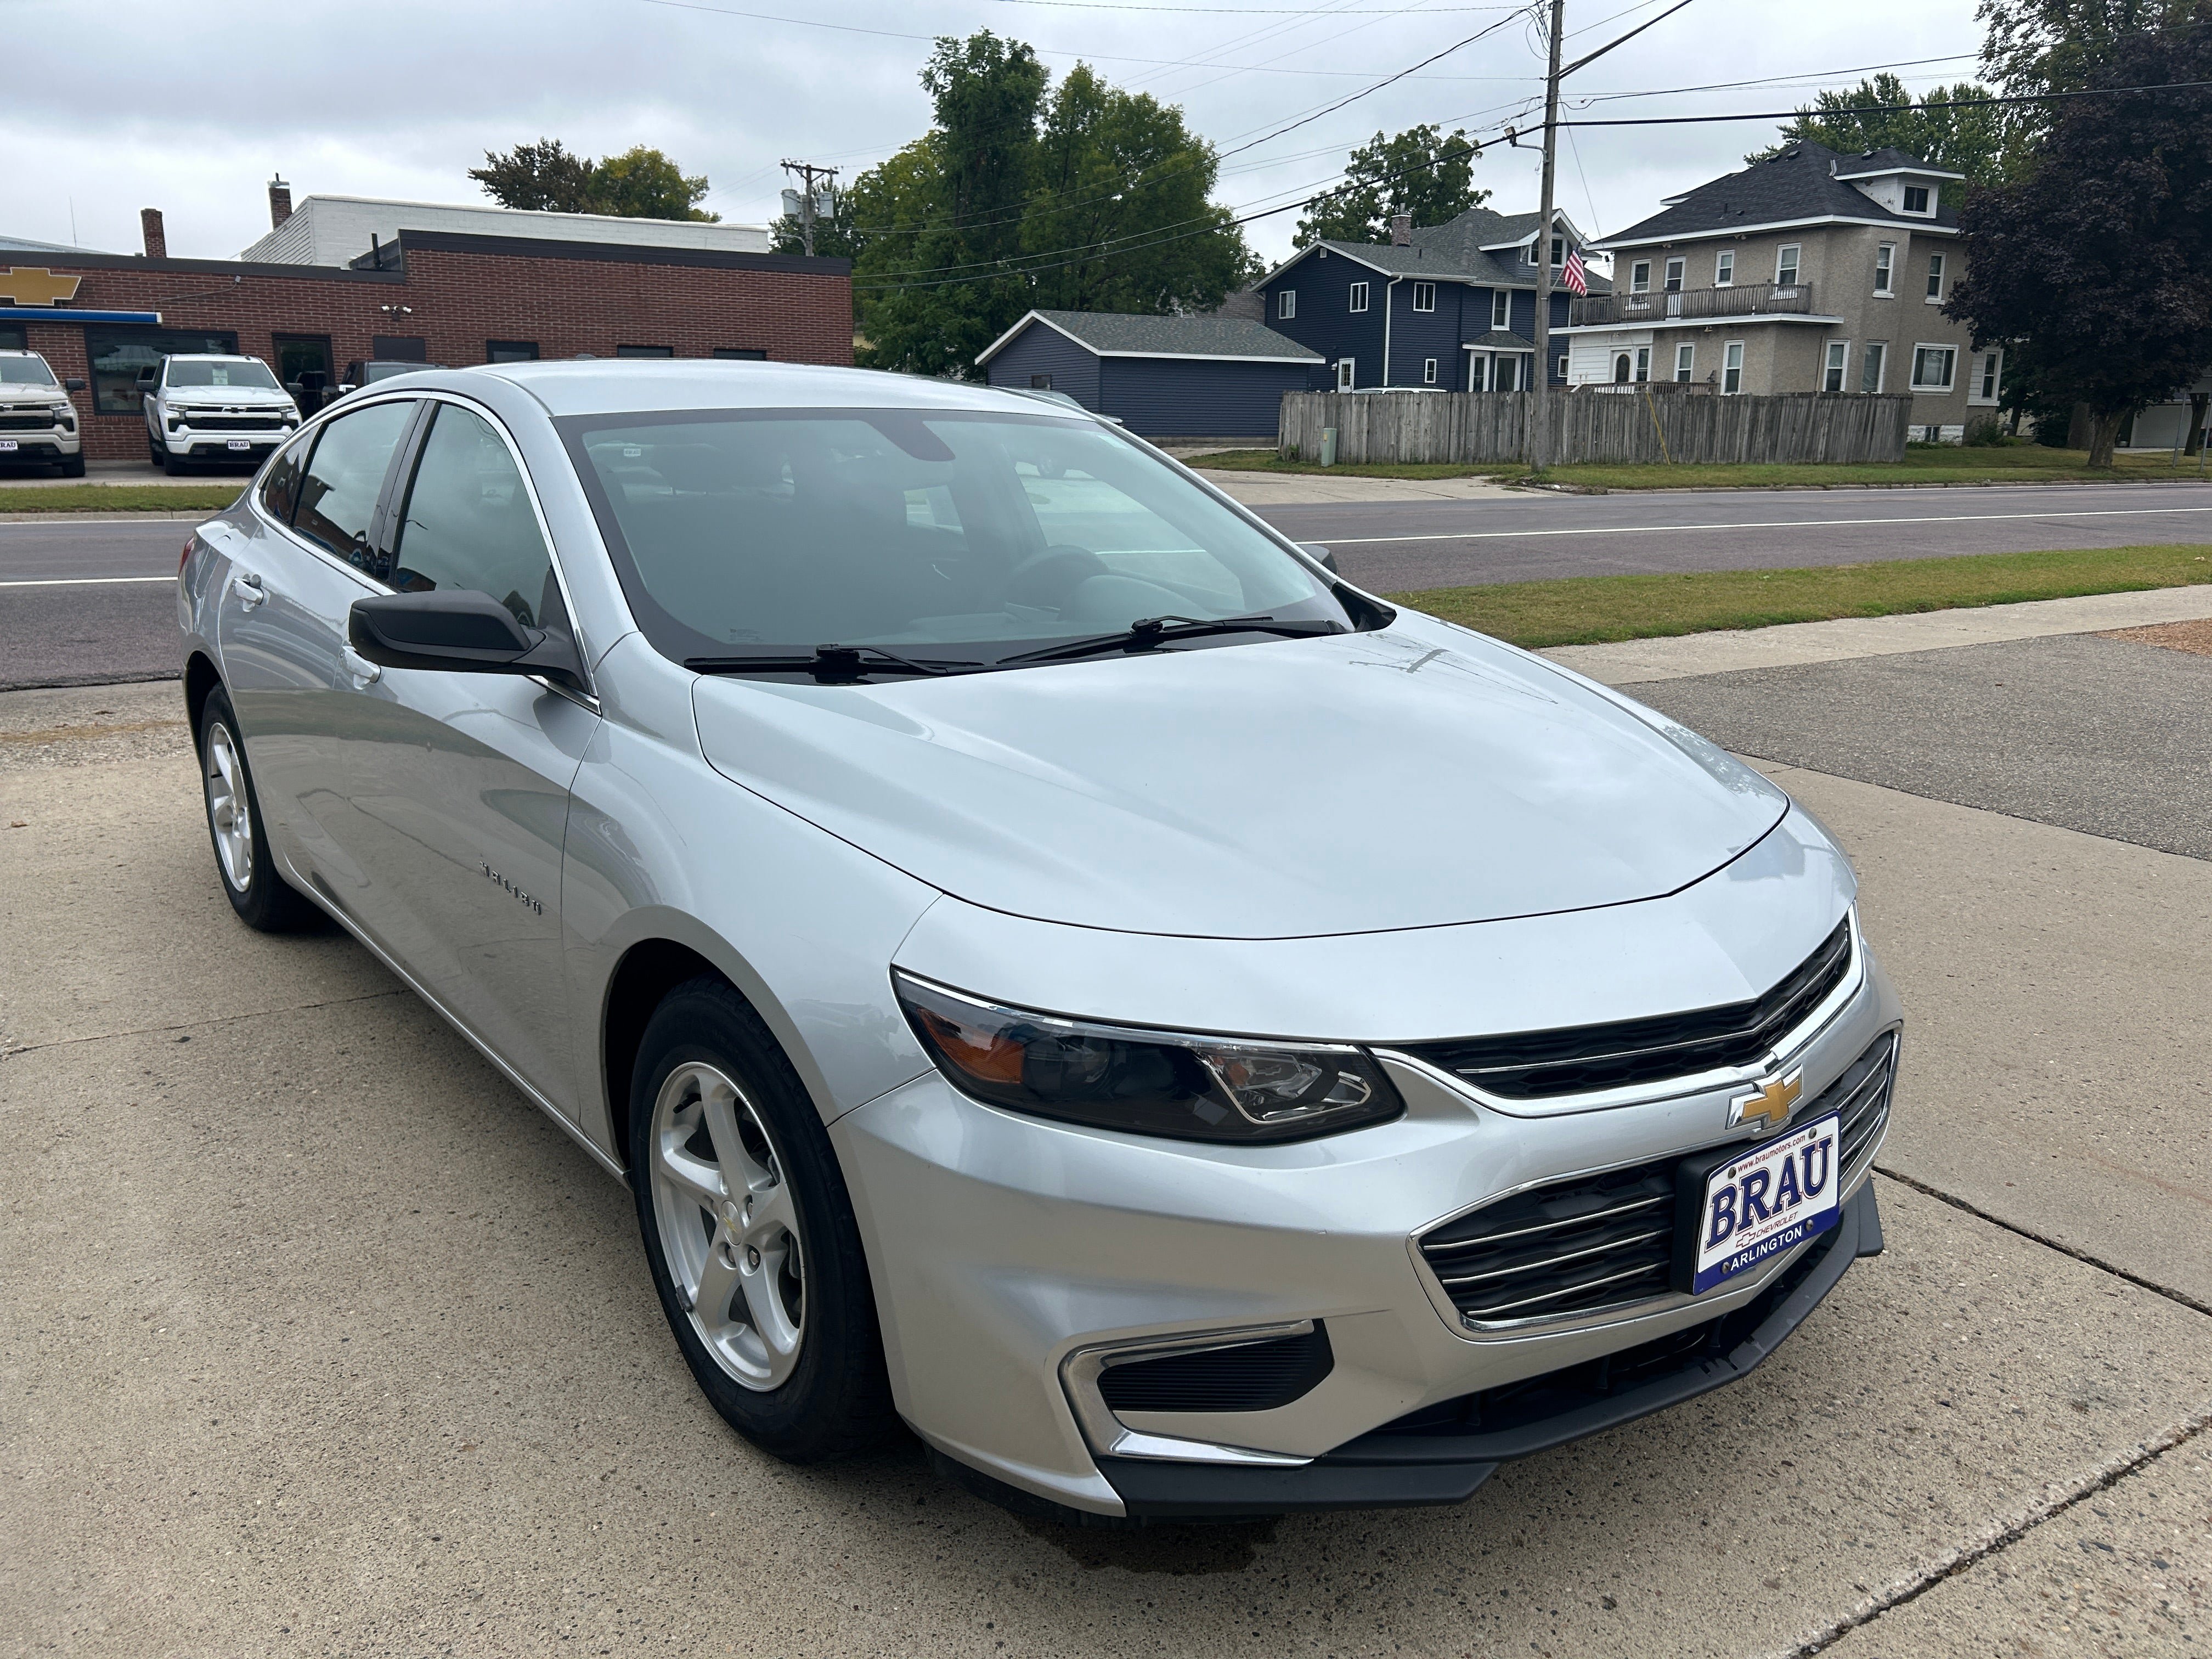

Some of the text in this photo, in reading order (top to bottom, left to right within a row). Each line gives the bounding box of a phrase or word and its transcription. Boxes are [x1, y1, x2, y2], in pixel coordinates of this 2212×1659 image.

[1737, 1135, 1805, 1172] www.braumotors.com
[1705, 1133, 1833, 1254] BRAU
[1756, 1211, 1798, 1238] CHEVROLET
[1730, 1225, 1802, 1271] ARLINGTON
